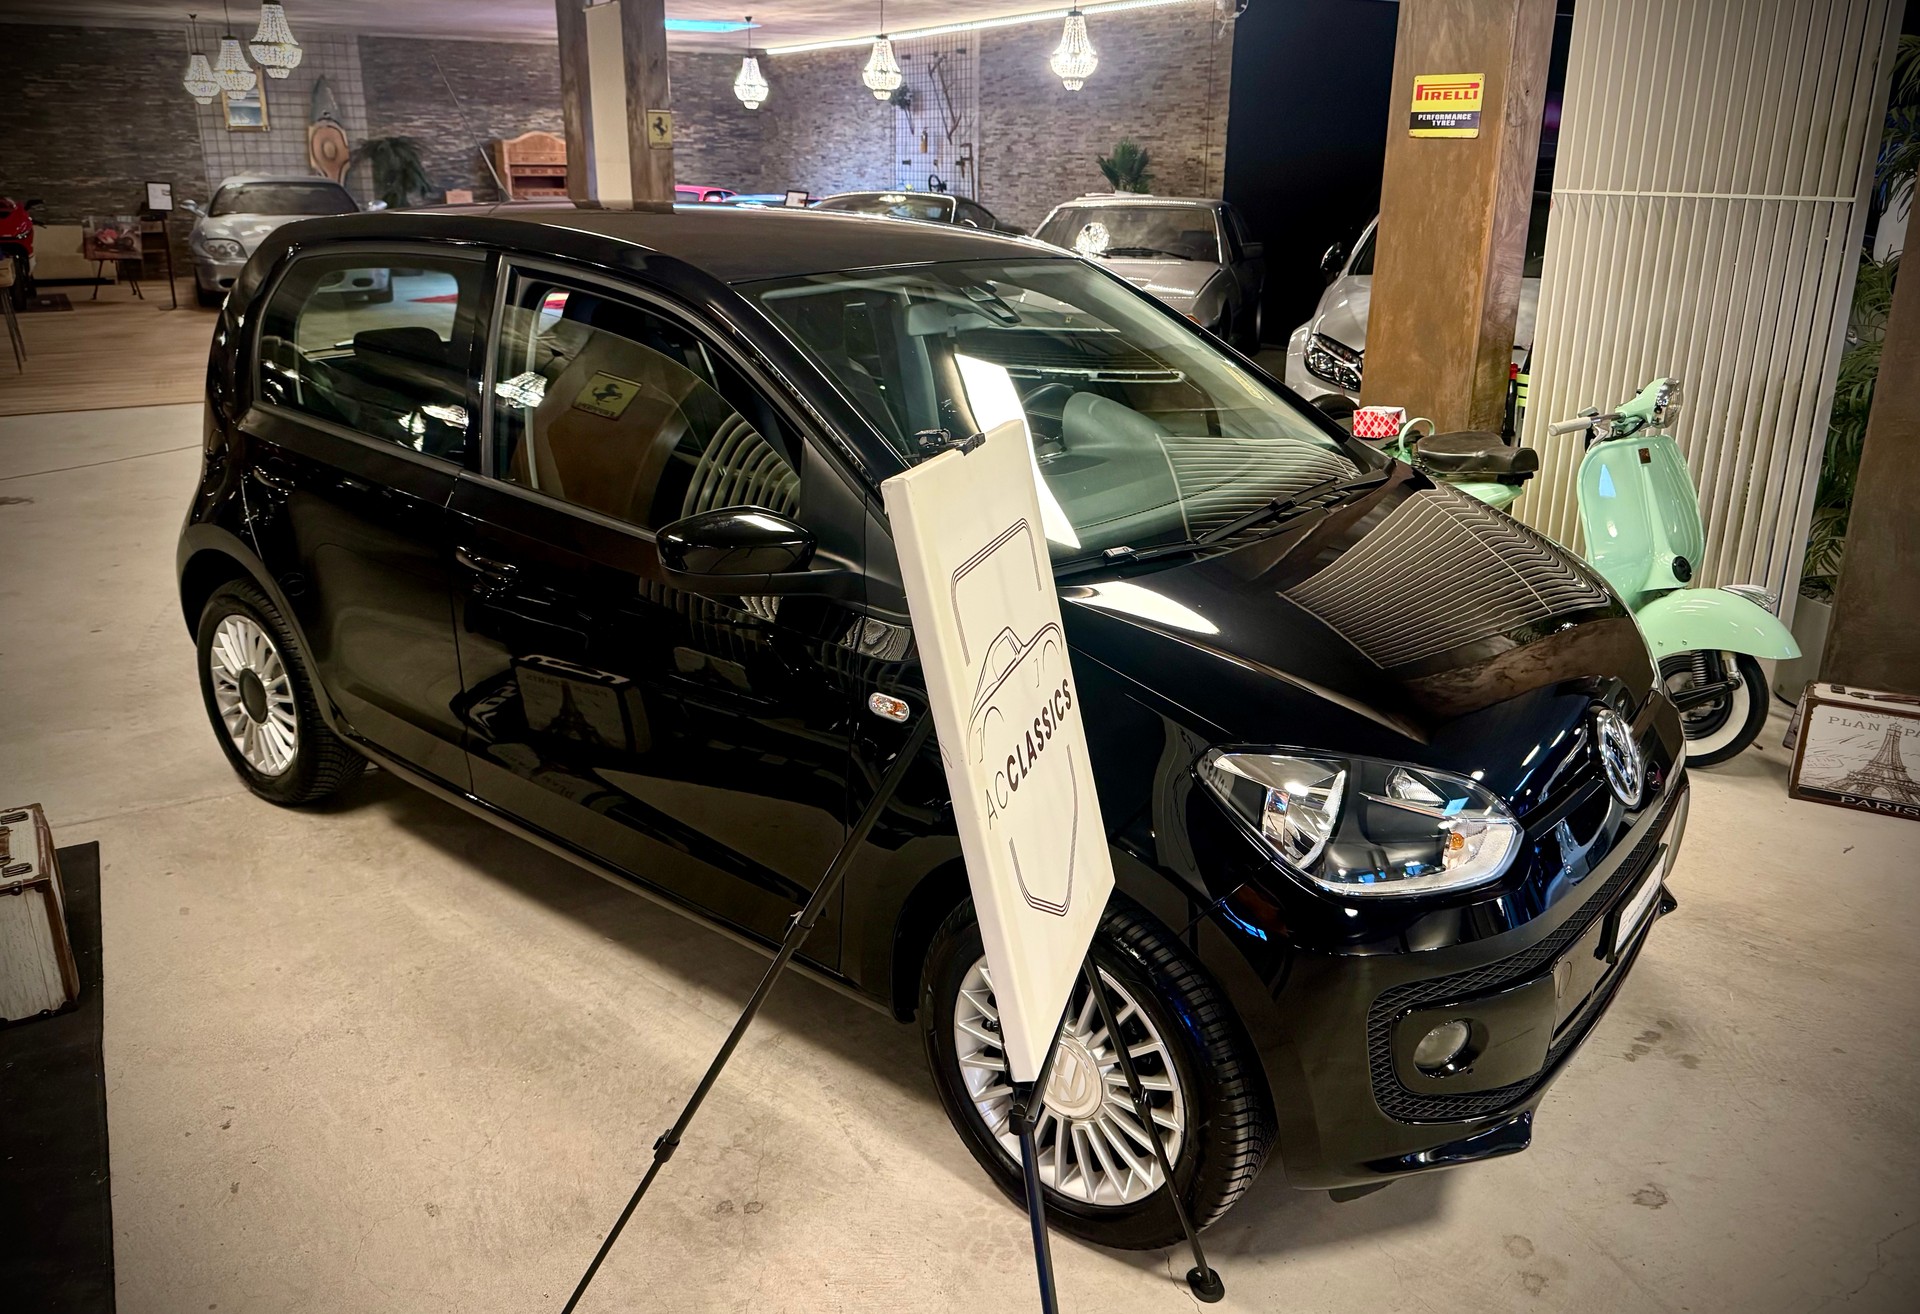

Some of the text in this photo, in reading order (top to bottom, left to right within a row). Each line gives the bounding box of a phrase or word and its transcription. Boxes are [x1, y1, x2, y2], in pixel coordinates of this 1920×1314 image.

[1416, 83, 1480, 101] PIRELLI
[1418, 113, 1472, 121] PERFORMANCE
[1828, 716, 1881, 732] PLAN
[1840, 795, 1919, 816] PARIS
